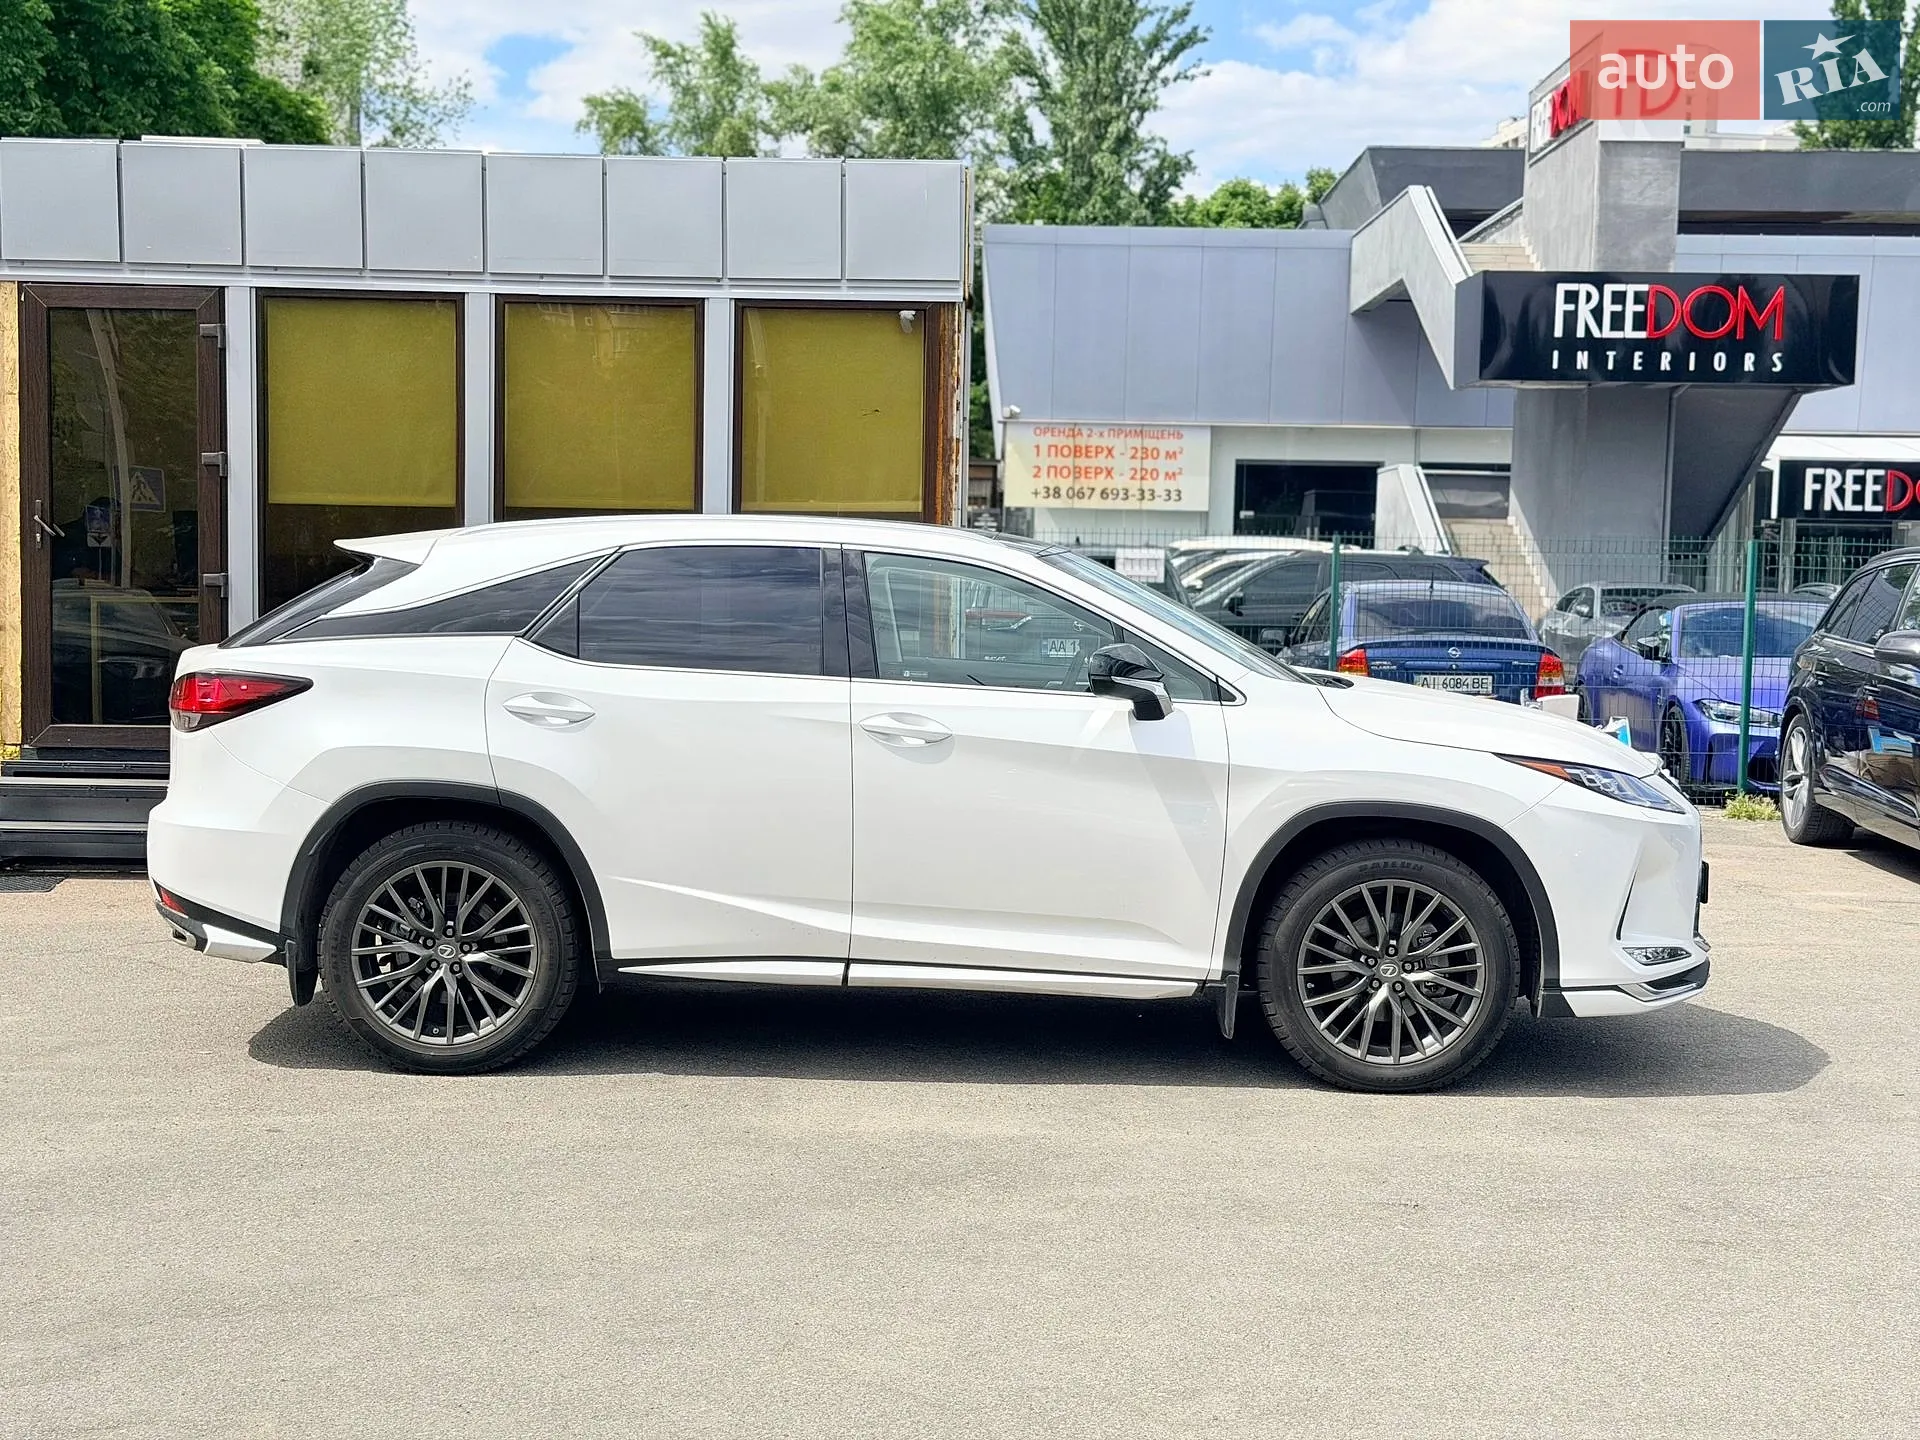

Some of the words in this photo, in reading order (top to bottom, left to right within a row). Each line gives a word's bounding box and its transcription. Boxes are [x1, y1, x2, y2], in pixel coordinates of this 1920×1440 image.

[1553, 283, 1785, 341] FREEDOM
[1552, 350, 1784, 372] INTERIORS
[1033, 427, 1084, 438] ОРЕНДА
[1109, 428, 1184, 440] ПРИМІЩЕНЬ
[1034, 445, 1041, 458] 1
[1047, 445, 1115, 459] ПОВЕРХ
[1129, 447, 1160, 460] 230
[1032, 466, 1041, 479] 2
[1046, 466, 1114, 480] ПОВЕРХ
[1129, 468, 1159, 481] 220
[1031, 487, 1061, 499] +38
[1066, 487, 1095, 500] 067
[1100, 487, 1182, 501] 693-33-33
[1804, 468, 1920, 512] FREED
[1050, 640, 1066, 652] AA
[1421, 677, 1436, 689] AI
[1442, 677, 1469, 689] 6084
[1472, 677, 1489, 689] BE
